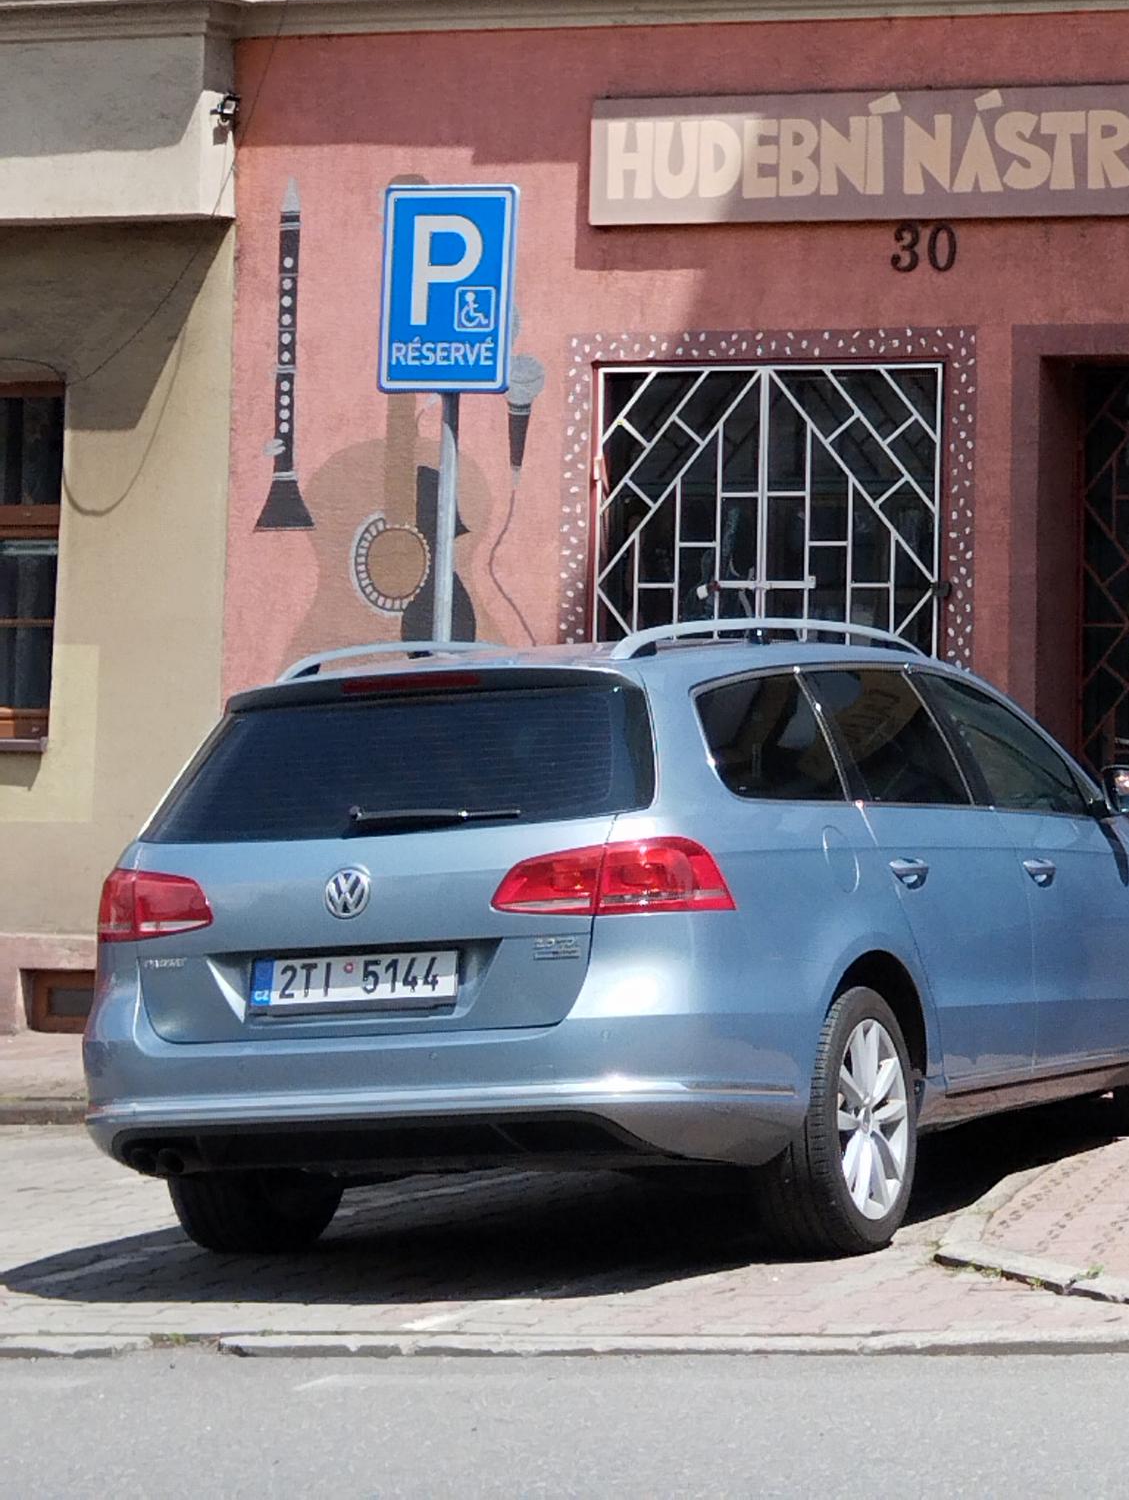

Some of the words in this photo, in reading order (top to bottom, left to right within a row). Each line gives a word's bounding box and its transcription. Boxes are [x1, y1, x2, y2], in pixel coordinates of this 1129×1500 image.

[606, 92, 901, 199] HUDEBNÍ
[410, 214, 484, 326] P
[890, 224, 957, 273] 30
[391, 336, 496, 367] RÉSERVÉ
[254, 990, 270, 1001] CZ
[278, 961, 333, 1000] 2TI
[361, 955, 440, 995] 5144
